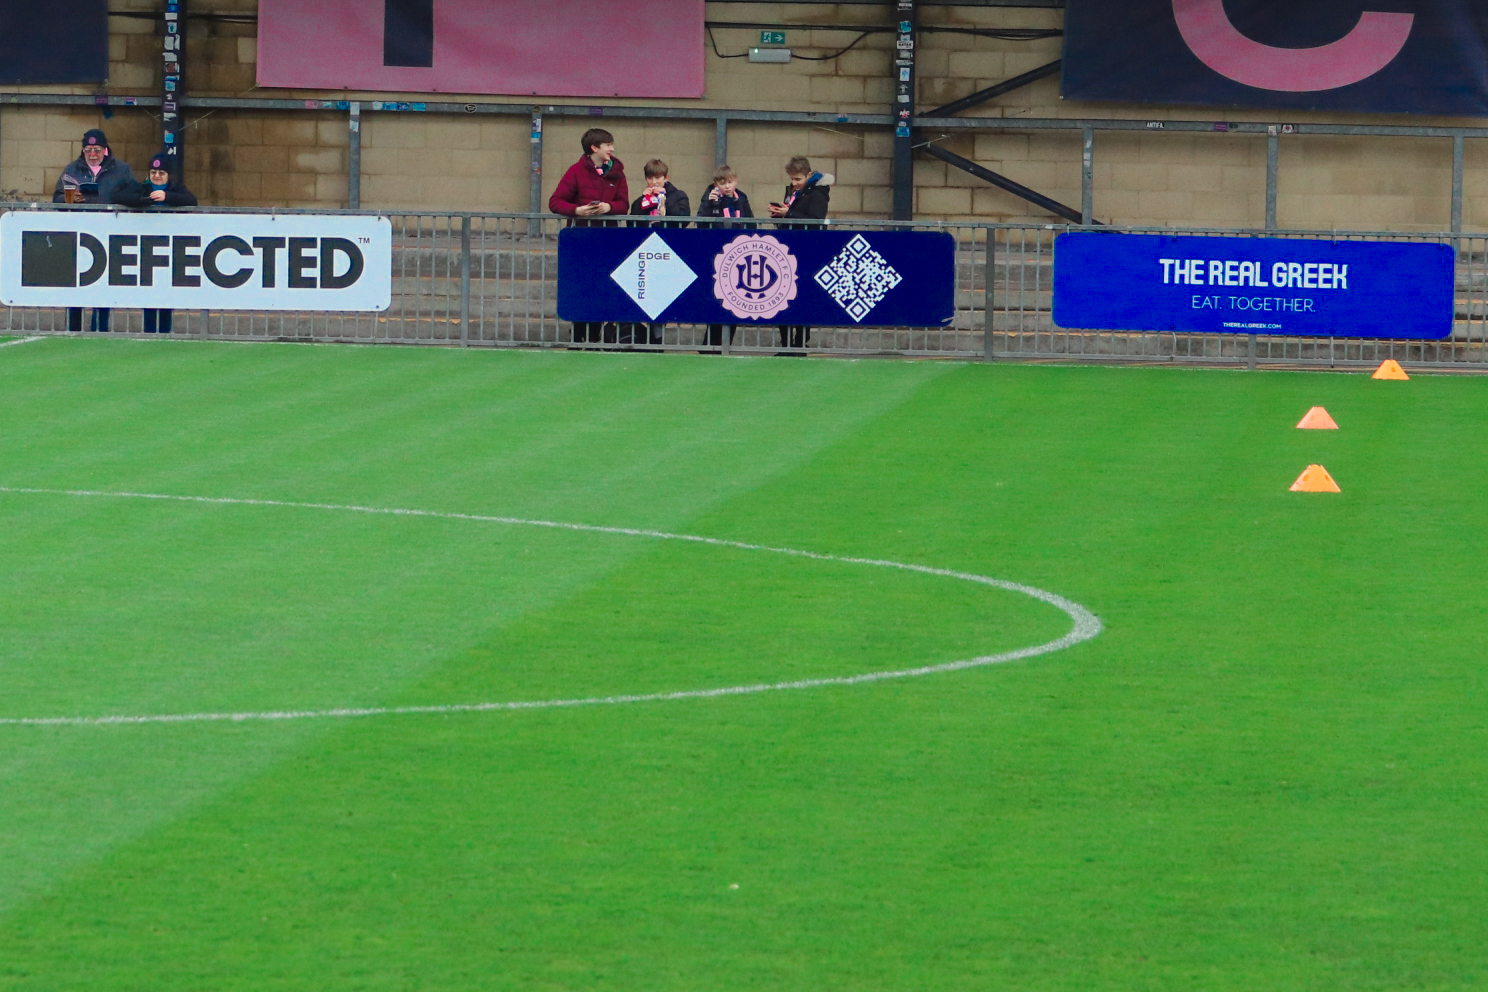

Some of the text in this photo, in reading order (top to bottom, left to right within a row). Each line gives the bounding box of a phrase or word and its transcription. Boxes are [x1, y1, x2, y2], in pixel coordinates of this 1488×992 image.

[638, 252, 671, 260] EDGE
[722, 244, 749, 278] DULWICH
[752, 243, 785, 263] HAMLET
[637, 260, 646, 300] RISING
[1159, 258, 1348, 290] THE REAL GREEK
[727, 291, 784, 311] FOUNDED 1893
[1192, 295, 1316, 313] EAT. TOGETHER.
